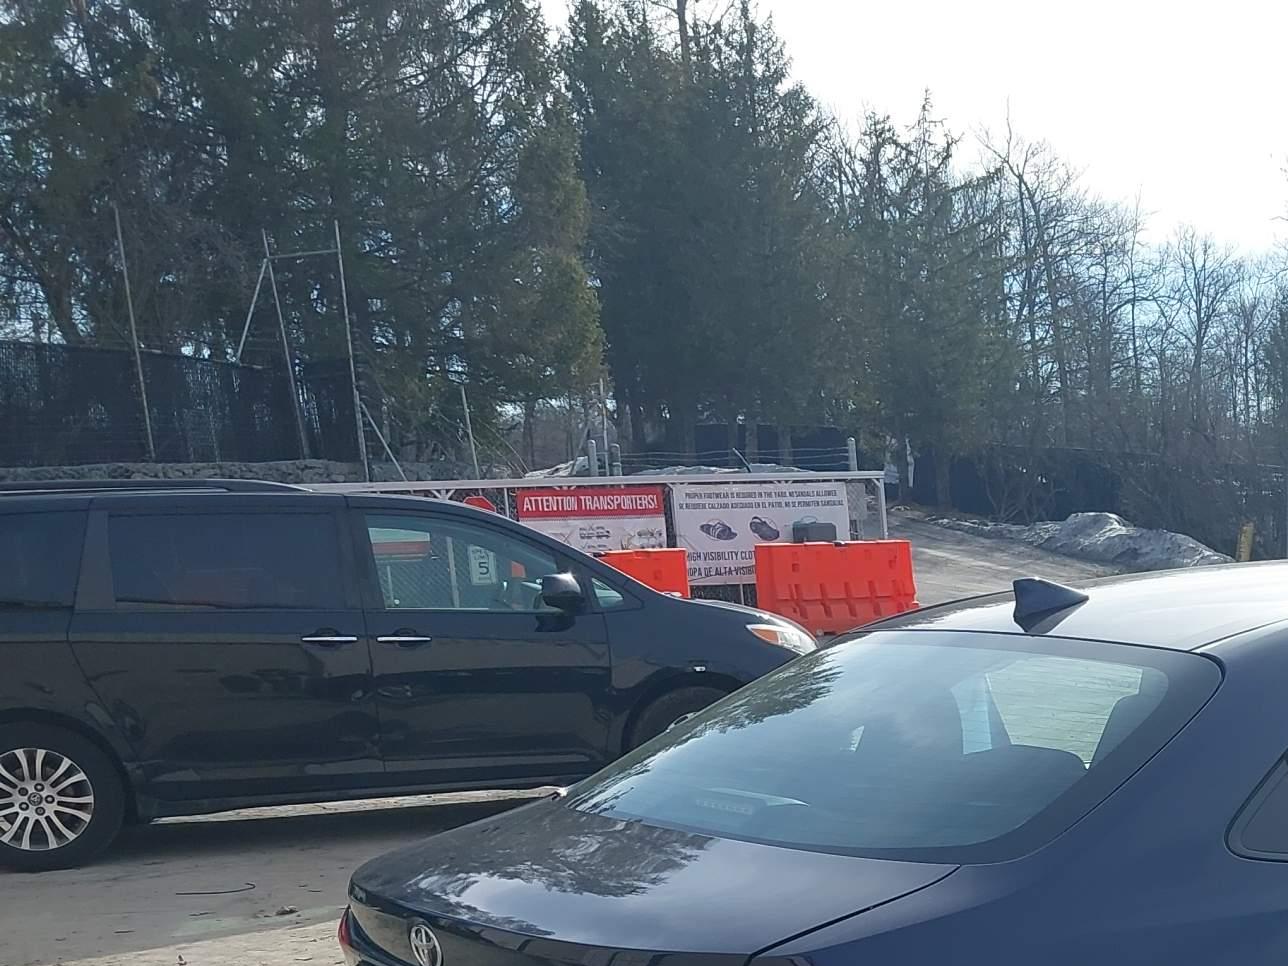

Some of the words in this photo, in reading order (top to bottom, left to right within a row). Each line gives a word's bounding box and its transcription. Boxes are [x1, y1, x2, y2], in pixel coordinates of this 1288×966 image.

[523, 495, 578, 512] ATTENTION
[579, 494, 658, 510] TRANSPORTERS!
[702, 550, 739, 561] VISIBILITY
[478, 561, 490, 575] 5
[704, 566, 713, 577] DE
[715, 566, 733, 577] ALTA
